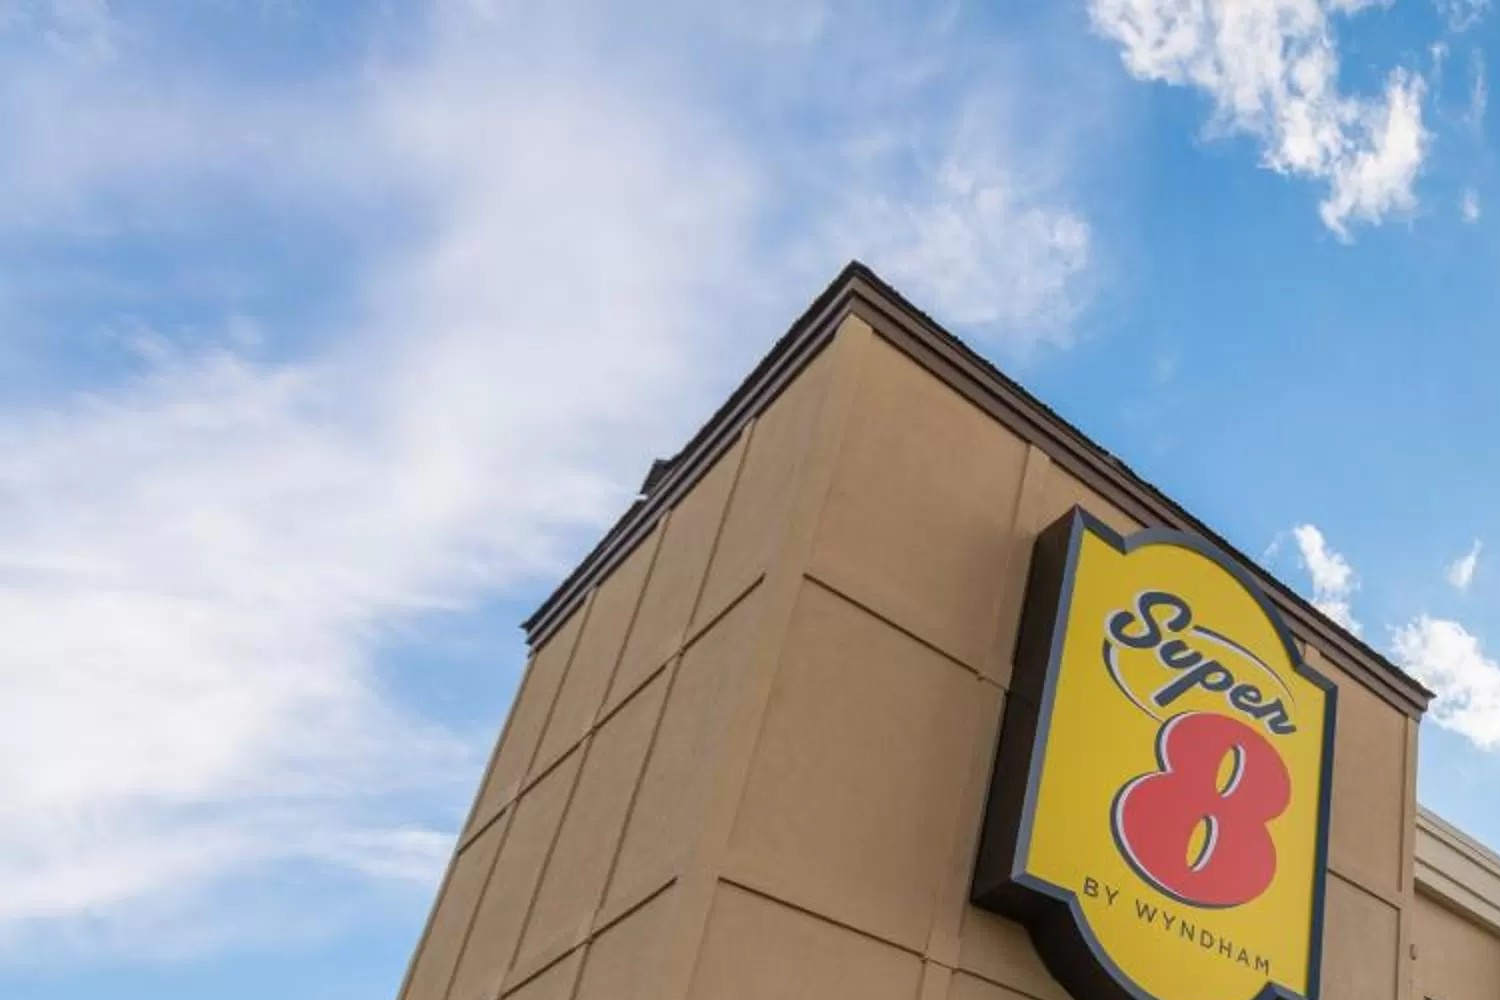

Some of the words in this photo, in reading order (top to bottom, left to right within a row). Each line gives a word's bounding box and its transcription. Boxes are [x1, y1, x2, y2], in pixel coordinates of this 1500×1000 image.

[1106, 590, 1297, 735] Super
[1110, 711, 1292, 909] 8
[1083, 876, 1119, 906] BY
[1135, 898, 1270, 976] WYNDHAM
